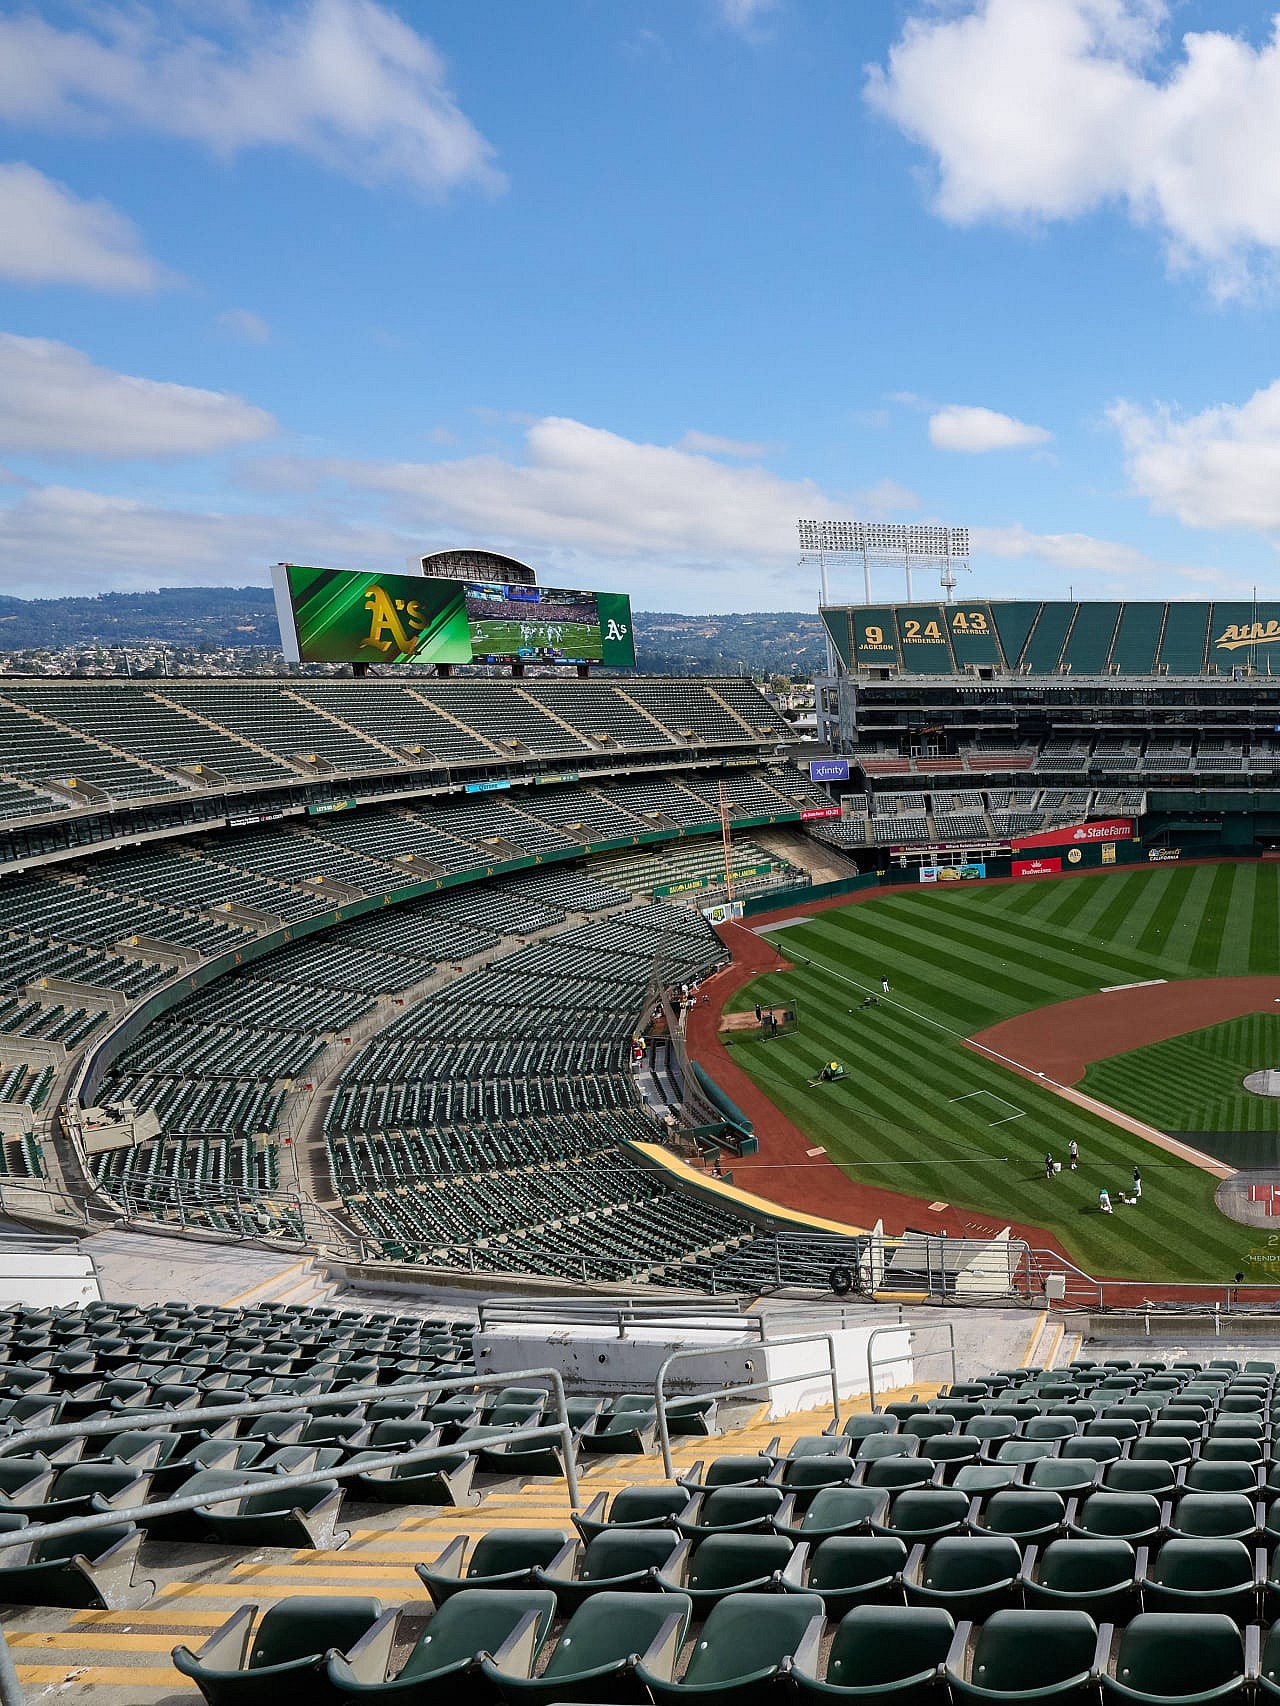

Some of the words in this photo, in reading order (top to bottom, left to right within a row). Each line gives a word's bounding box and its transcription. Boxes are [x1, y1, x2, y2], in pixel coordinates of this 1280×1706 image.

[360, 584, 430, 655] A's
[952, 612, 987, 630] 43
[604, 618, 627, 641] A's
[865, 626, 883, 645] 9
[904, 620, 942, 638] 24
[816, 766, 844, 776] xfinity
[1021, 868, 1051, 876] Budweiser
